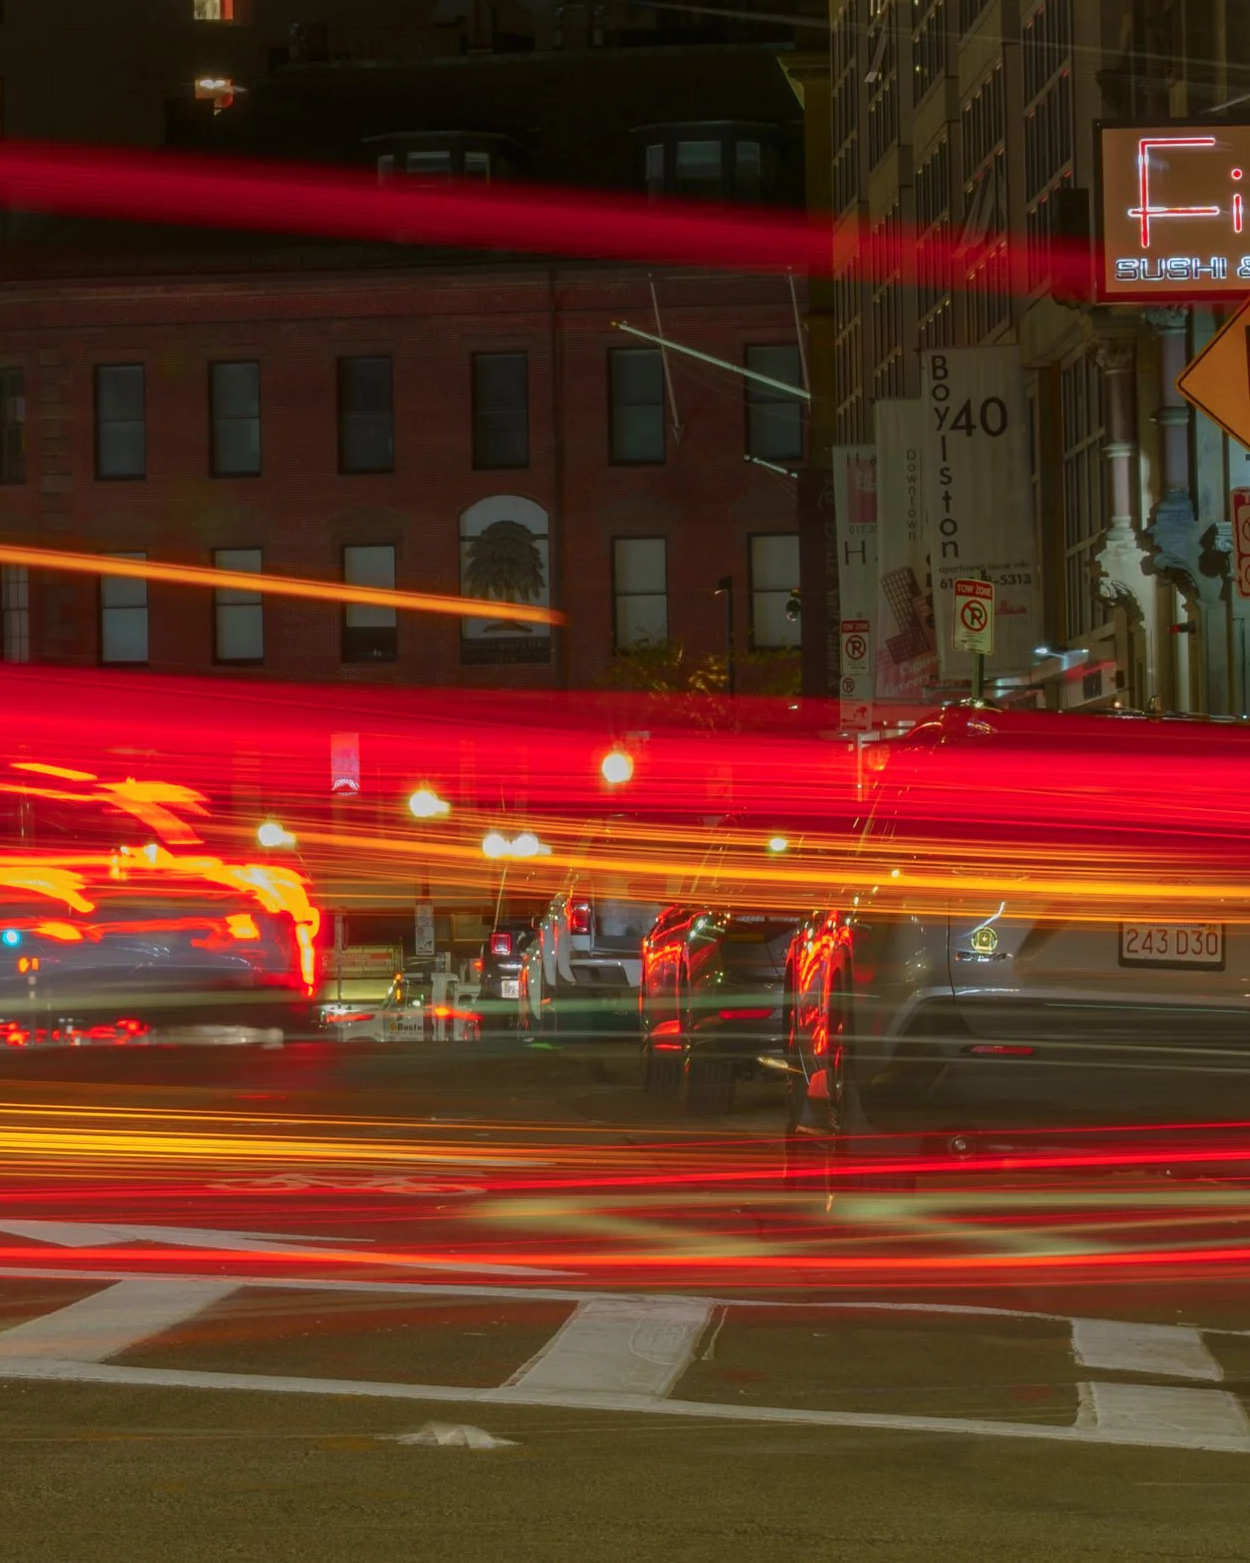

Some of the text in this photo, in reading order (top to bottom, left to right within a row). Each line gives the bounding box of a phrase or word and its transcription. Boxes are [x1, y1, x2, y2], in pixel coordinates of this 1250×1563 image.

[1116, 257, 1227, 281] SUSHI
[949, 396, 1008, 437] 40
[931, 355, 959, 559] Boylston
[906, 449, 918, 541] Downtown
[957, 583, 992, 597] TOW ZONE
[1126, 928, 1218, 956] 243 D30
